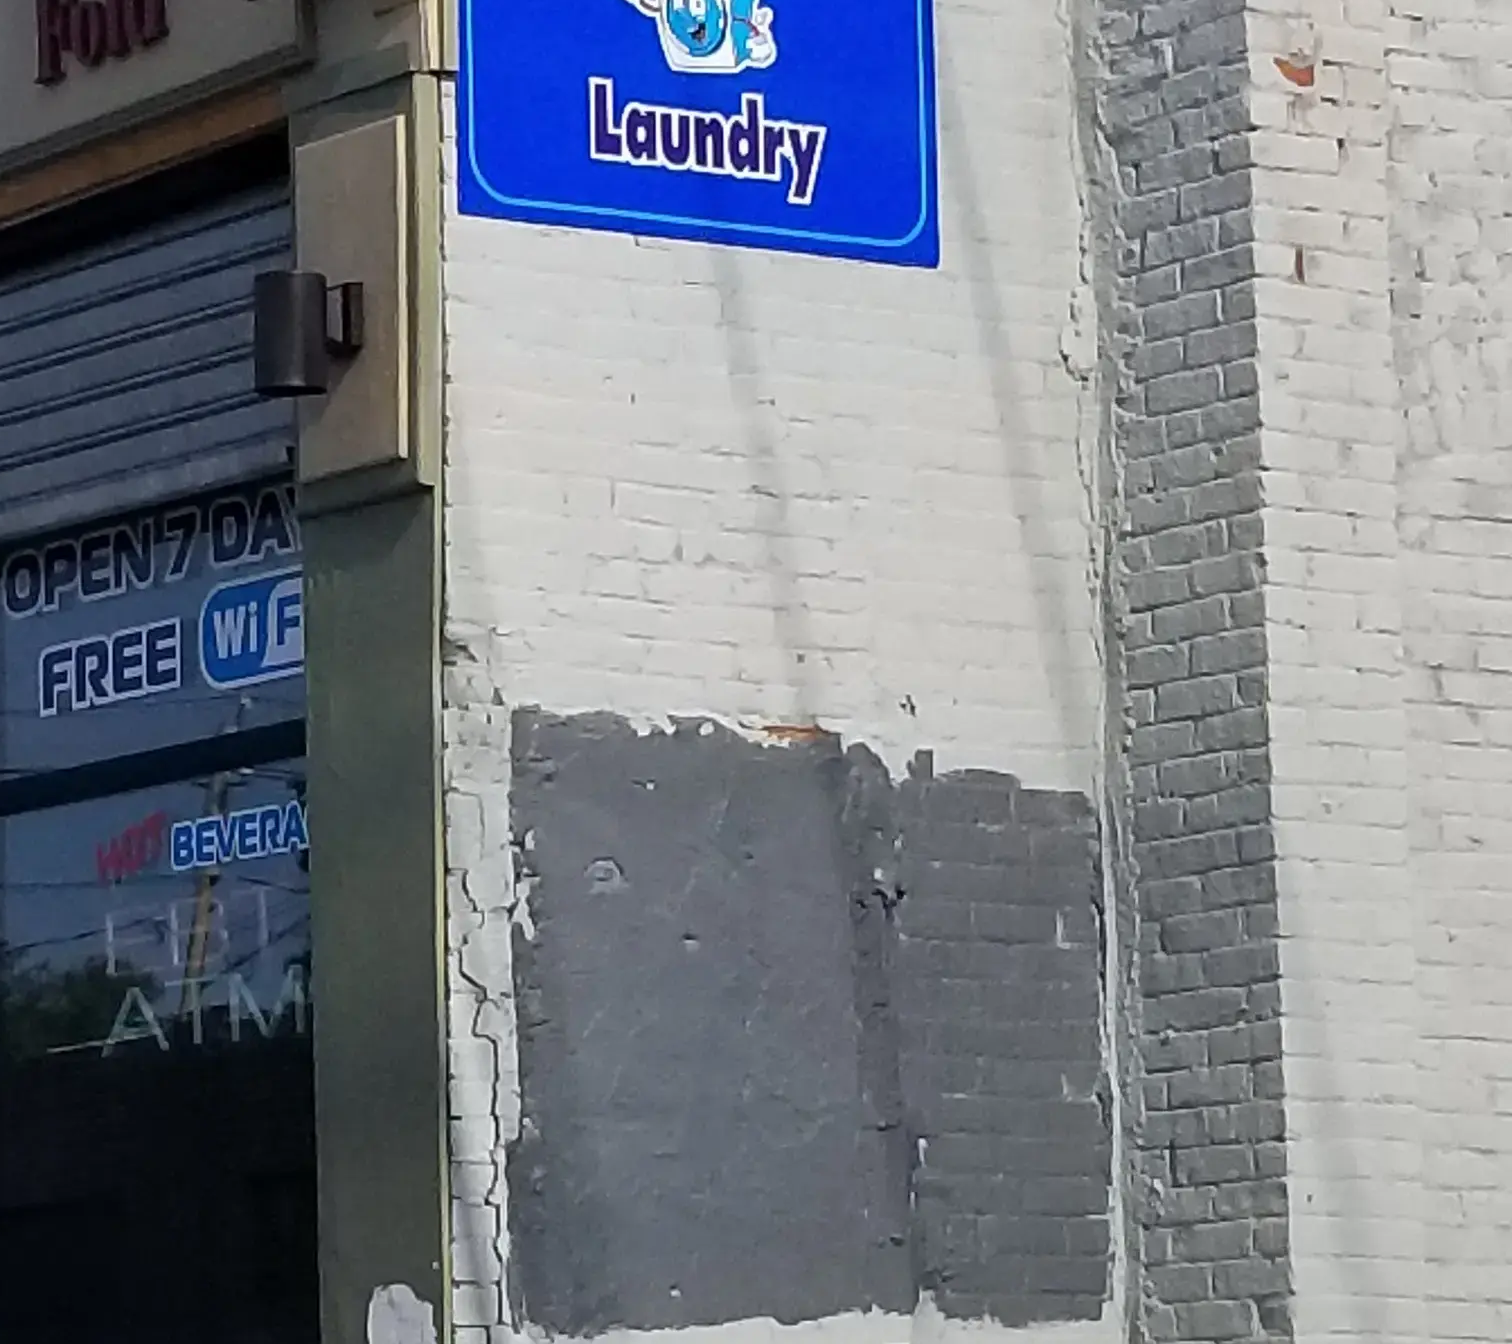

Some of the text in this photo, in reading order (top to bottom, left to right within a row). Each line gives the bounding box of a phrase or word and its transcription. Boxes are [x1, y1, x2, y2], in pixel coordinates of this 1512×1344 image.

[589, 77, 826, 206] Laundry
[2, 516, 155, 619] OPEN
[162, 504, 201, 582] 7
[40, 617, 182, 718] FREE
[170, 799, 309, 871] BEVERA
[100, 964, 308, 1058] ATM
